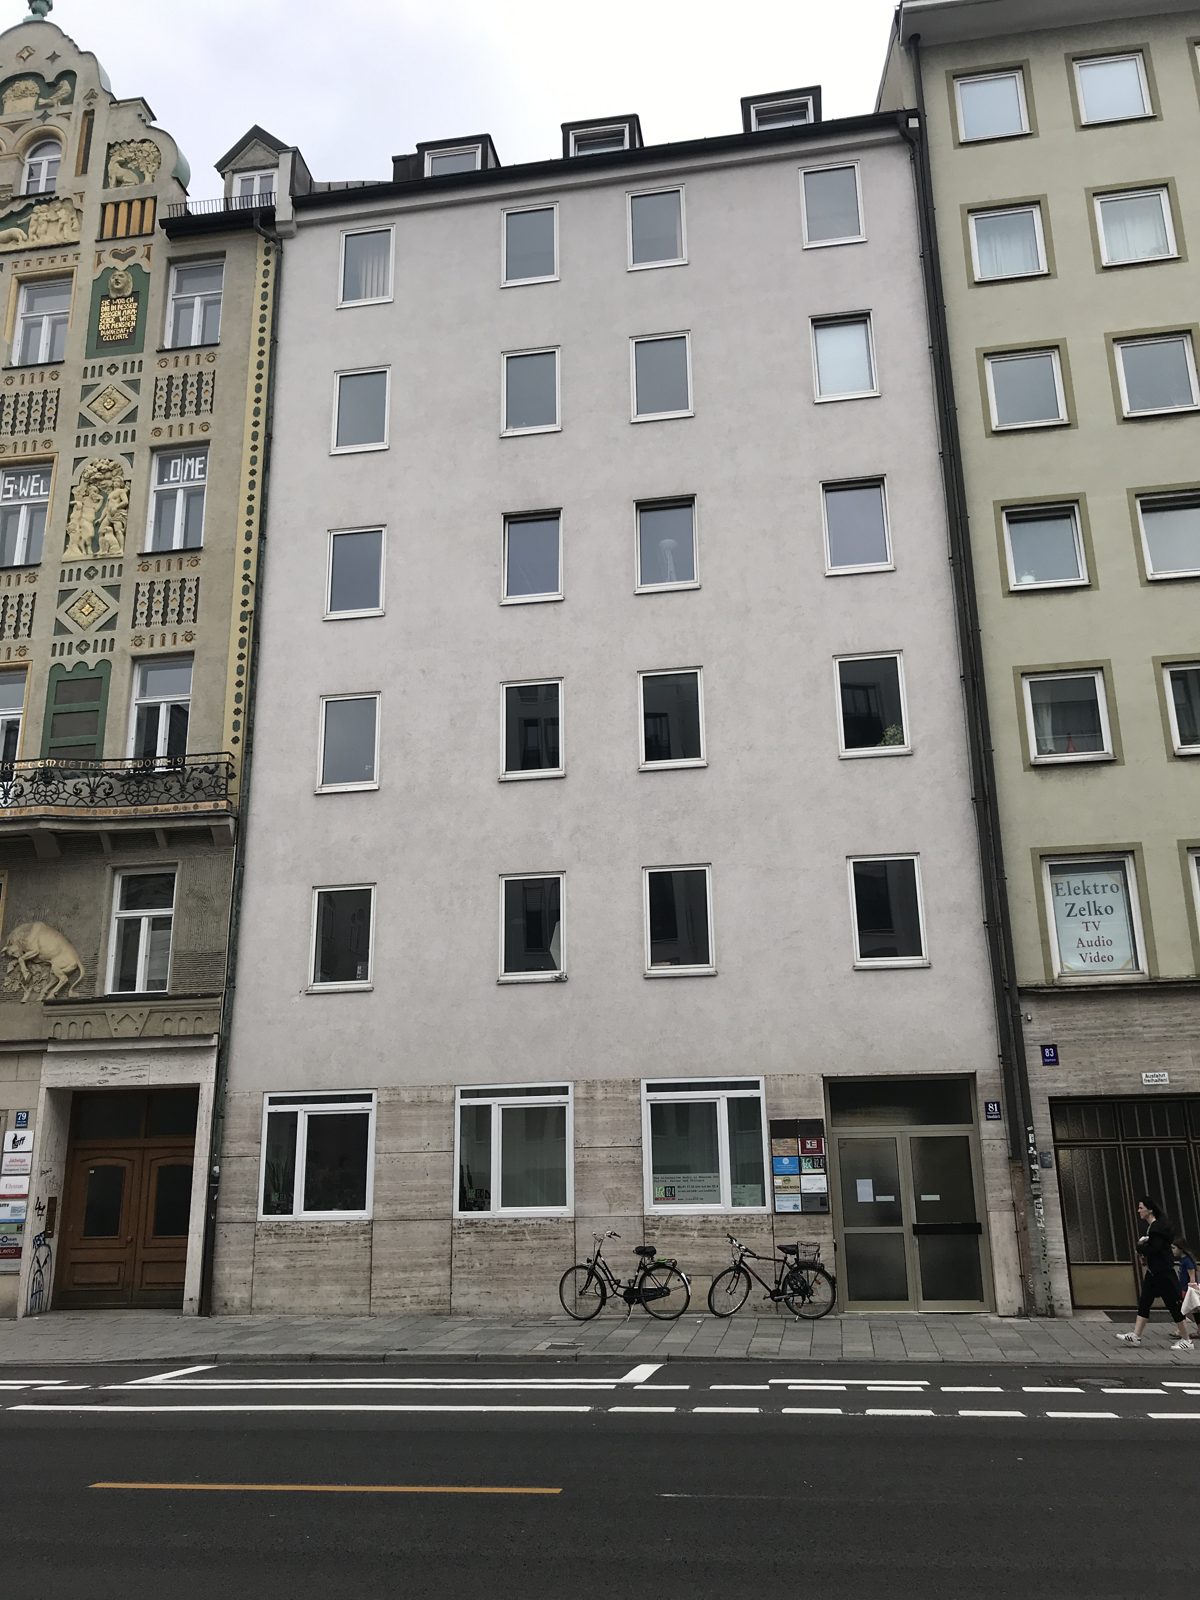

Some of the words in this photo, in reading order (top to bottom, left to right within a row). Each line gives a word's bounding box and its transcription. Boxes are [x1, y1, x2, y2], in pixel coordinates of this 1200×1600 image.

[1054, 880, 1120, 897] Elektro
[1065, 901, 1114, 918] Zelko
[1082, 921, 1101, 932] TV
[1076, 936, 1113, 948] Audio
[1079, 952, 1114, 963] Video
[1044, 1048, 1054, 1057] 83
[988, 1103, 998, 1112] 81
[17, 1112, 27, 1120] 79
